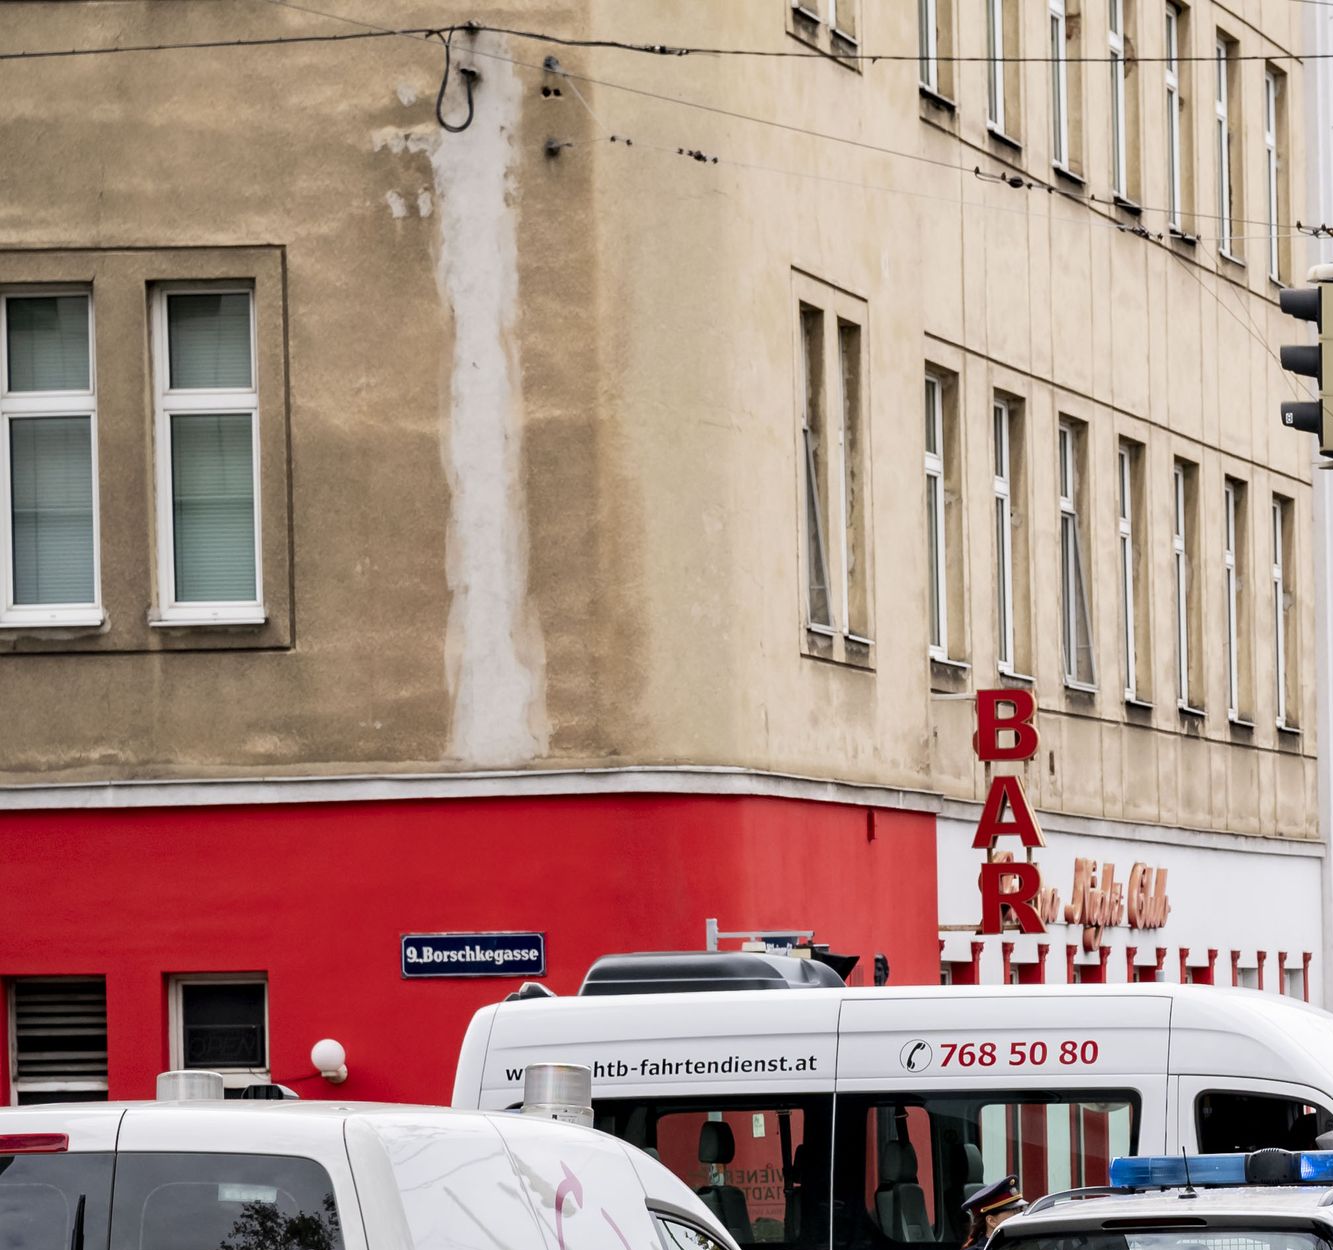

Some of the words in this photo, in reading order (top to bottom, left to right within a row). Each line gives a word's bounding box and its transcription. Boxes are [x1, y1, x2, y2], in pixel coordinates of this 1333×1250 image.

[972, 689, 1047, 935] BAR
[422, 945, 539, 965] Borschkegasse
[940, 1042, 997, 1067] 768
[1008, 1041, 1048, 1066] 50
[1058, 1040, 1099, 1065] 80
